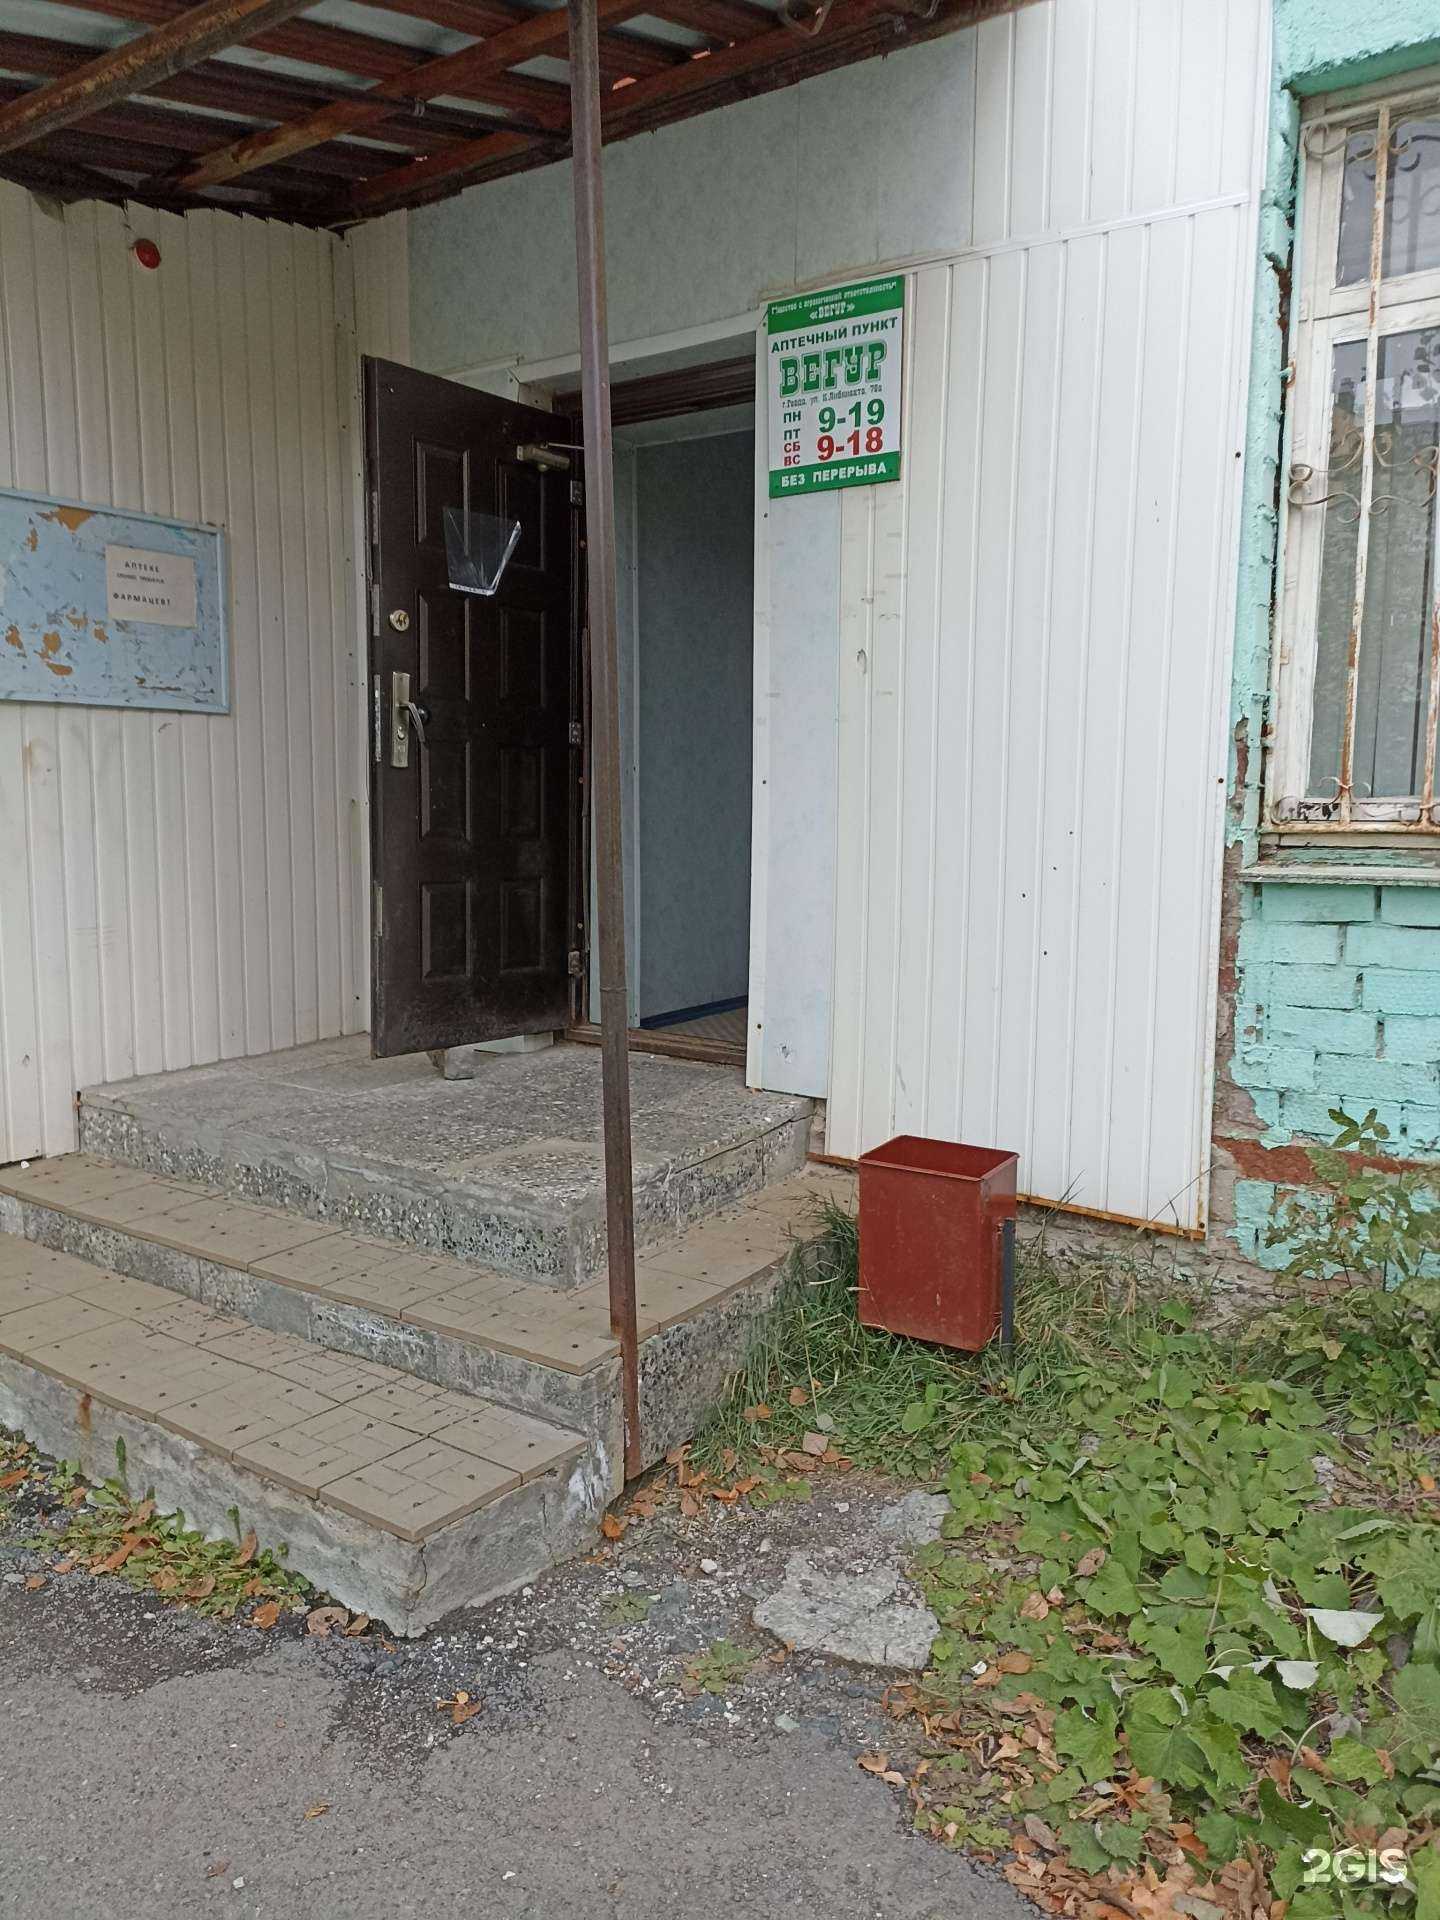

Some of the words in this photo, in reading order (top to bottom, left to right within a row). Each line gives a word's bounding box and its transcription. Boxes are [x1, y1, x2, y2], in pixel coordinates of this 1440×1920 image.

[771, 327, 847, 353] АПТЕЧНЫЙ
[852, 317, 898, 336] ПУНКТ
[779, 340, 887, 398] ВЕГУР
[783, 411, 801, 424] ПН
[818, 399, 885, 434] 9-19
[784, 429, 801, 441] ПТ
[816, 427, 883, 461] 9-18
[784, 441, 801, 454] СБ
[784, 455, 801, 467] ВС
[781, 473, 805, 488] БЕЗ
[812, 463, 887, 483] ПЕРЕРЫВА
[112, 592, 171, 606] ФАРМАЦЕВТ
